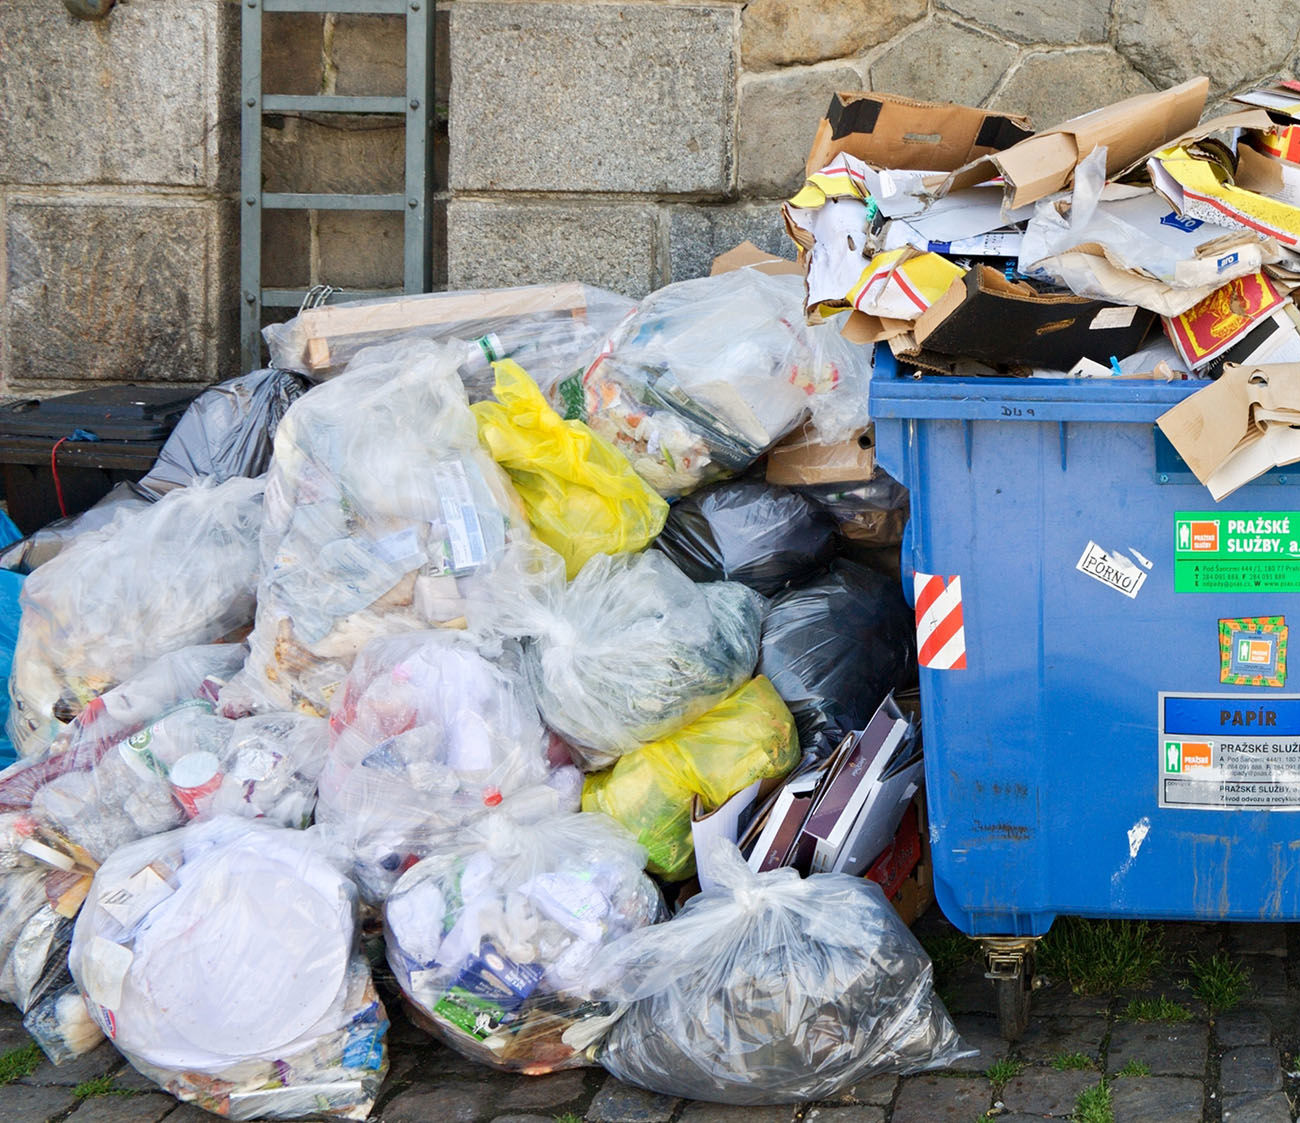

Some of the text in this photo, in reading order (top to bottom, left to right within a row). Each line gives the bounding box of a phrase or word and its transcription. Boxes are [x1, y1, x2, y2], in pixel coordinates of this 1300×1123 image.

[1227, 516, 1290, 534] PRAŽSKÉ
[1227, 536, 1284, 553] SLUŽBY,
[1086, 555, 1132, 588] PORNO
[1220, 705, 1277, 726] PAPÍR
[1220, 742, 1269, 753] PRAŽSKÉ
[1219, 784, 1256, 793] PRAŽSKÉ
